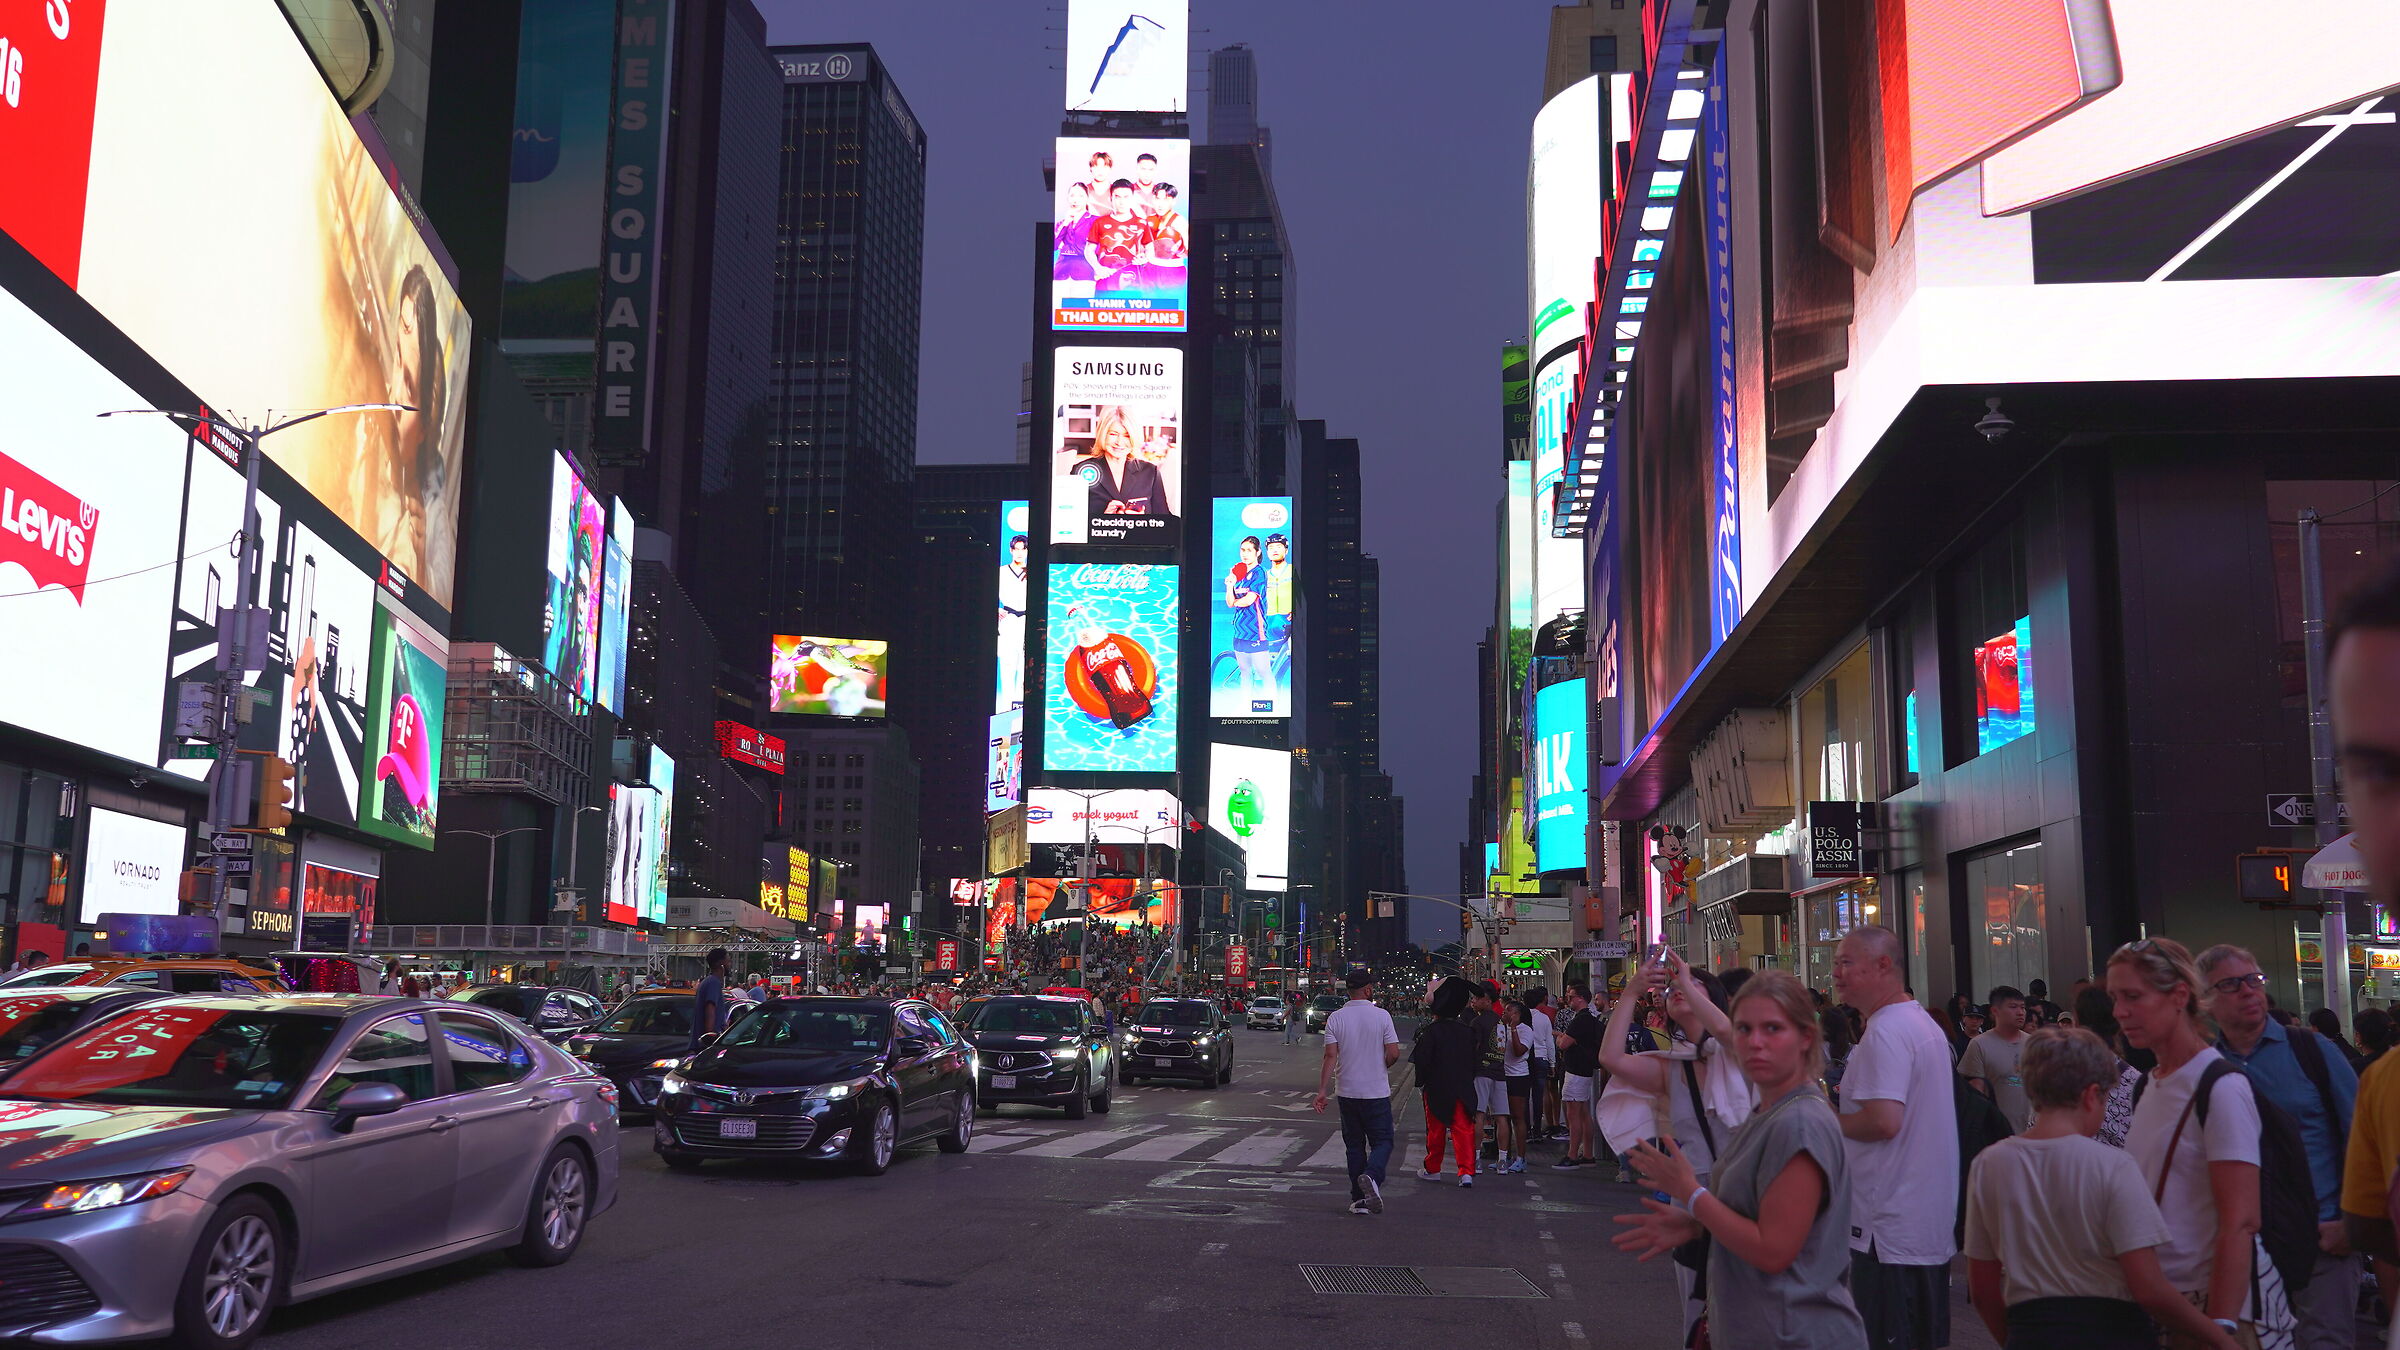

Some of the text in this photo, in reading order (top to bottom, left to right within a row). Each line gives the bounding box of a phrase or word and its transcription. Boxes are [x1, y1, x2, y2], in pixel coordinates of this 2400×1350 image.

[605, 164, 645, 417] SQUARE
[1088, 298, 1151, 309] THANK YOU
[1061, 311, 1179, 324] THAI OLYMPIANS
[1072, 361, 1164, 376] SAMSUNG
[1091, 518, 1134, 530] Checking
[1149, 518, 1165, 528] the
[1091, 528, 1127, 539] laundry
[1103, 809, 1139, 822] yogurt
[2284, 804, 2313, 816] ONE
[1815, 827, 1840, 838] U.S.
[232, 840, 244, 848] WAY
[1815, 838, 1853, 850] POLO
[1815, 850, 1856, 862] ASSN.
[113, 859, 160, 881] VORNADO
[228, 862, 246, 871] WAY
[2274, 866, 2289, 892] 4
[2325, 872, 2340, 881] HOT
[252, 911, 293, 933] SEPHORA
[941, 943, 955, 970] tkts
[1231, 948, 1245, 975] tkts
